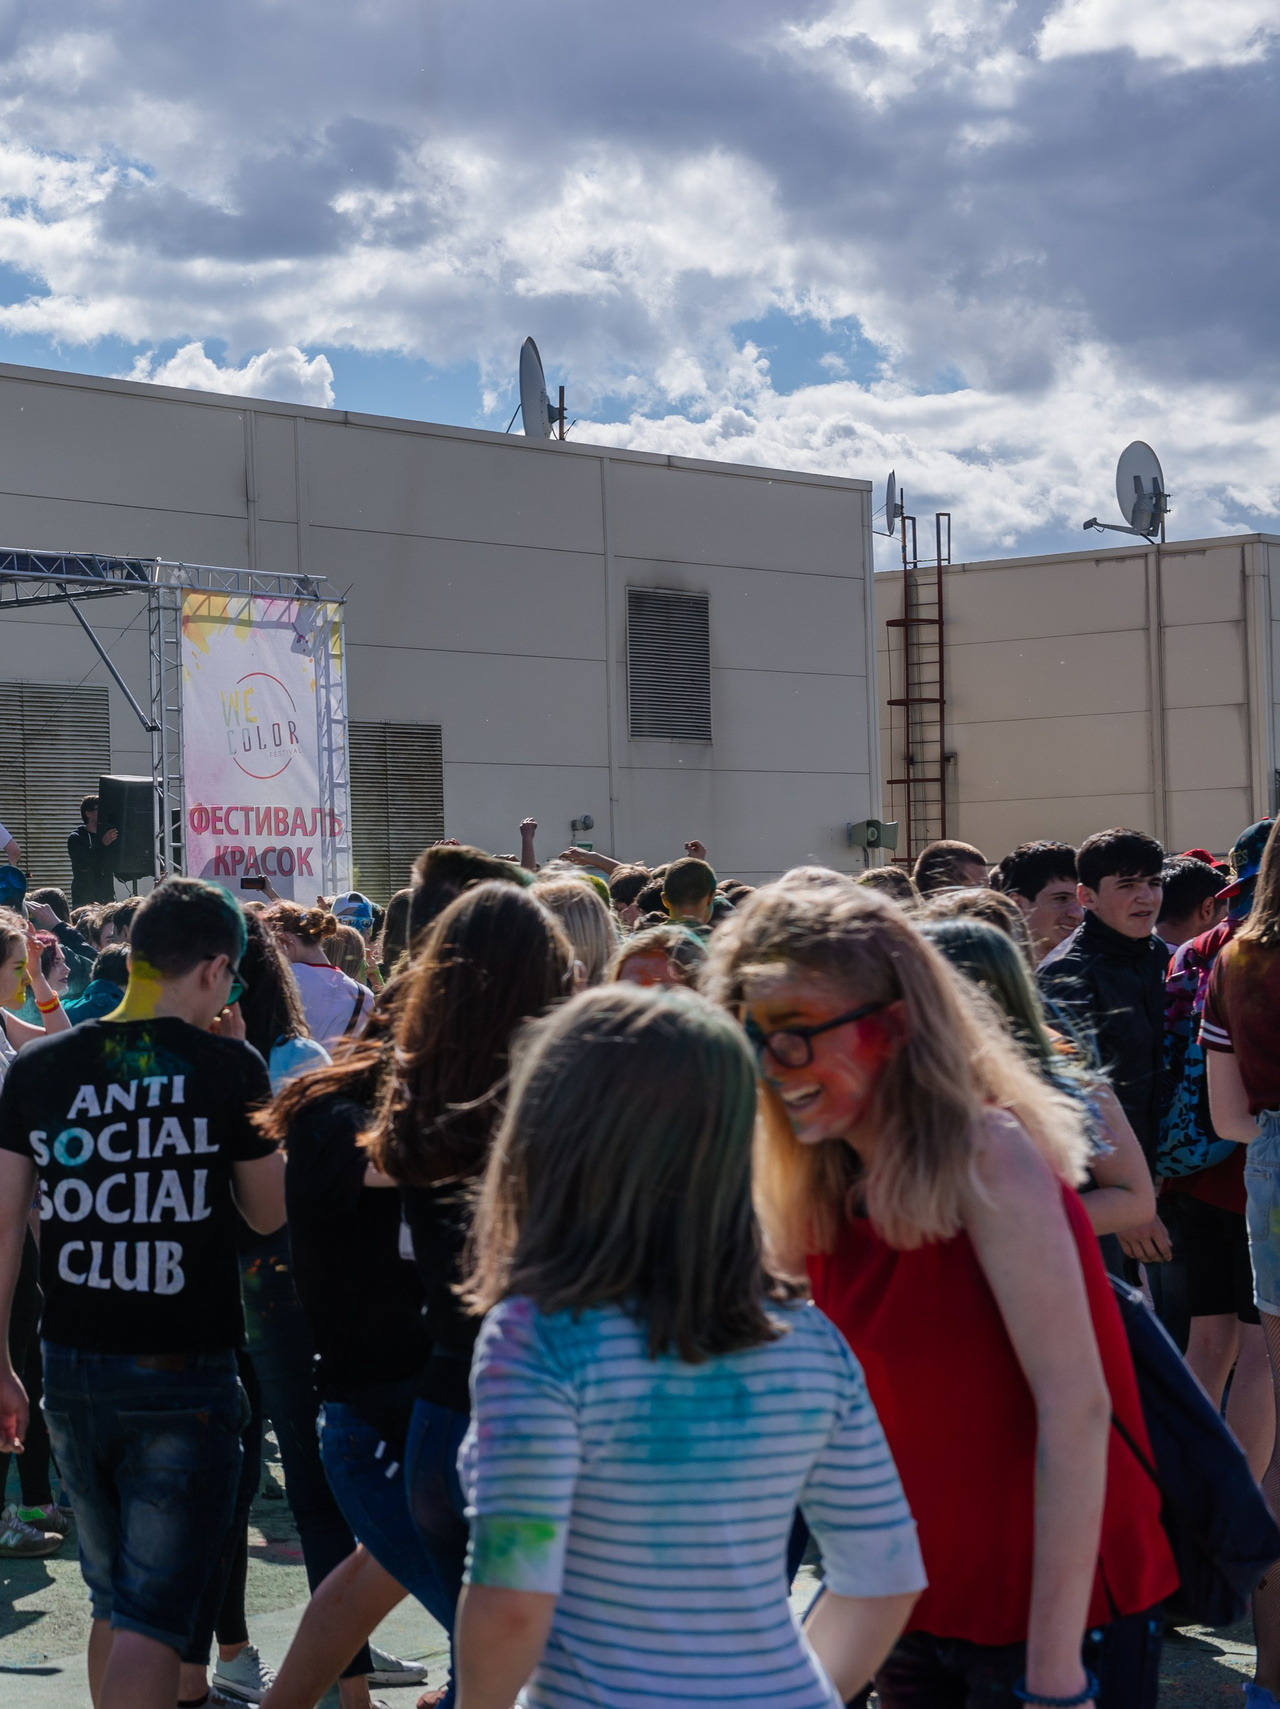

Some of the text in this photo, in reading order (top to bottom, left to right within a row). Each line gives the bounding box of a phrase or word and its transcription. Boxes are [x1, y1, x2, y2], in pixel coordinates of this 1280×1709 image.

[220, 686, 257, 728] WE
[226, 720, 299, 756] COLOR
[269, 748, 303, 759] FESTIVAL
[189, 803, 343, 837] ФЕСТИВАЛЬ
[214, 845, 314, 877] КРАСОК
[67, 1074, 186, 1120] ANTI
[29, 1117, 220, 1167] SOCIAL
[39, 1169, 212, 1224] SOCIAL
[58, 1240, 186, 1296] CLUB
